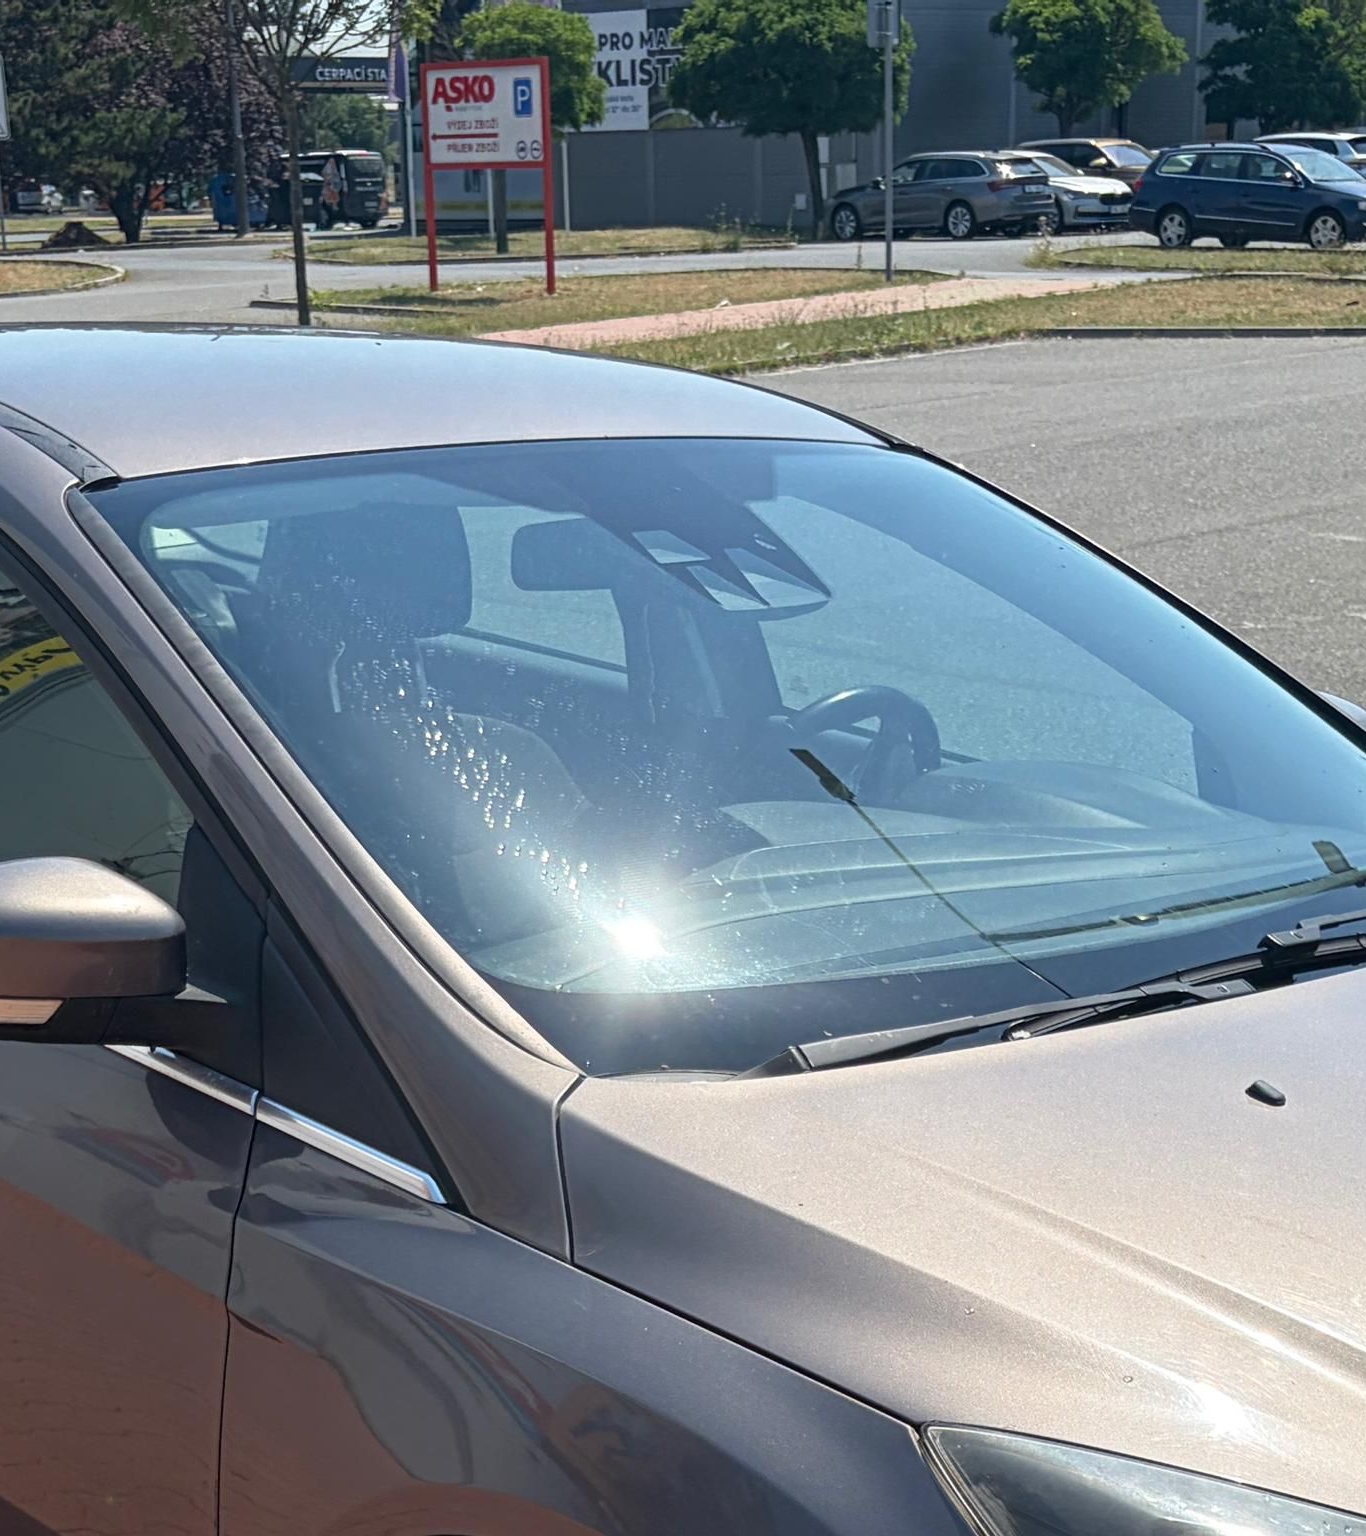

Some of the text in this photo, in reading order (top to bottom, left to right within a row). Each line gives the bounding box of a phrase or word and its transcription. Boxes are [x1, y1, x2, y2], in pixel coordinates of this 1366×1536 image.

[598, 31, 634, 51] PRO
[315, 65, 365, 81] ČERPACÍ
[432, 75, 495, 104] ASKO
[516, 85, 530, 112] P
